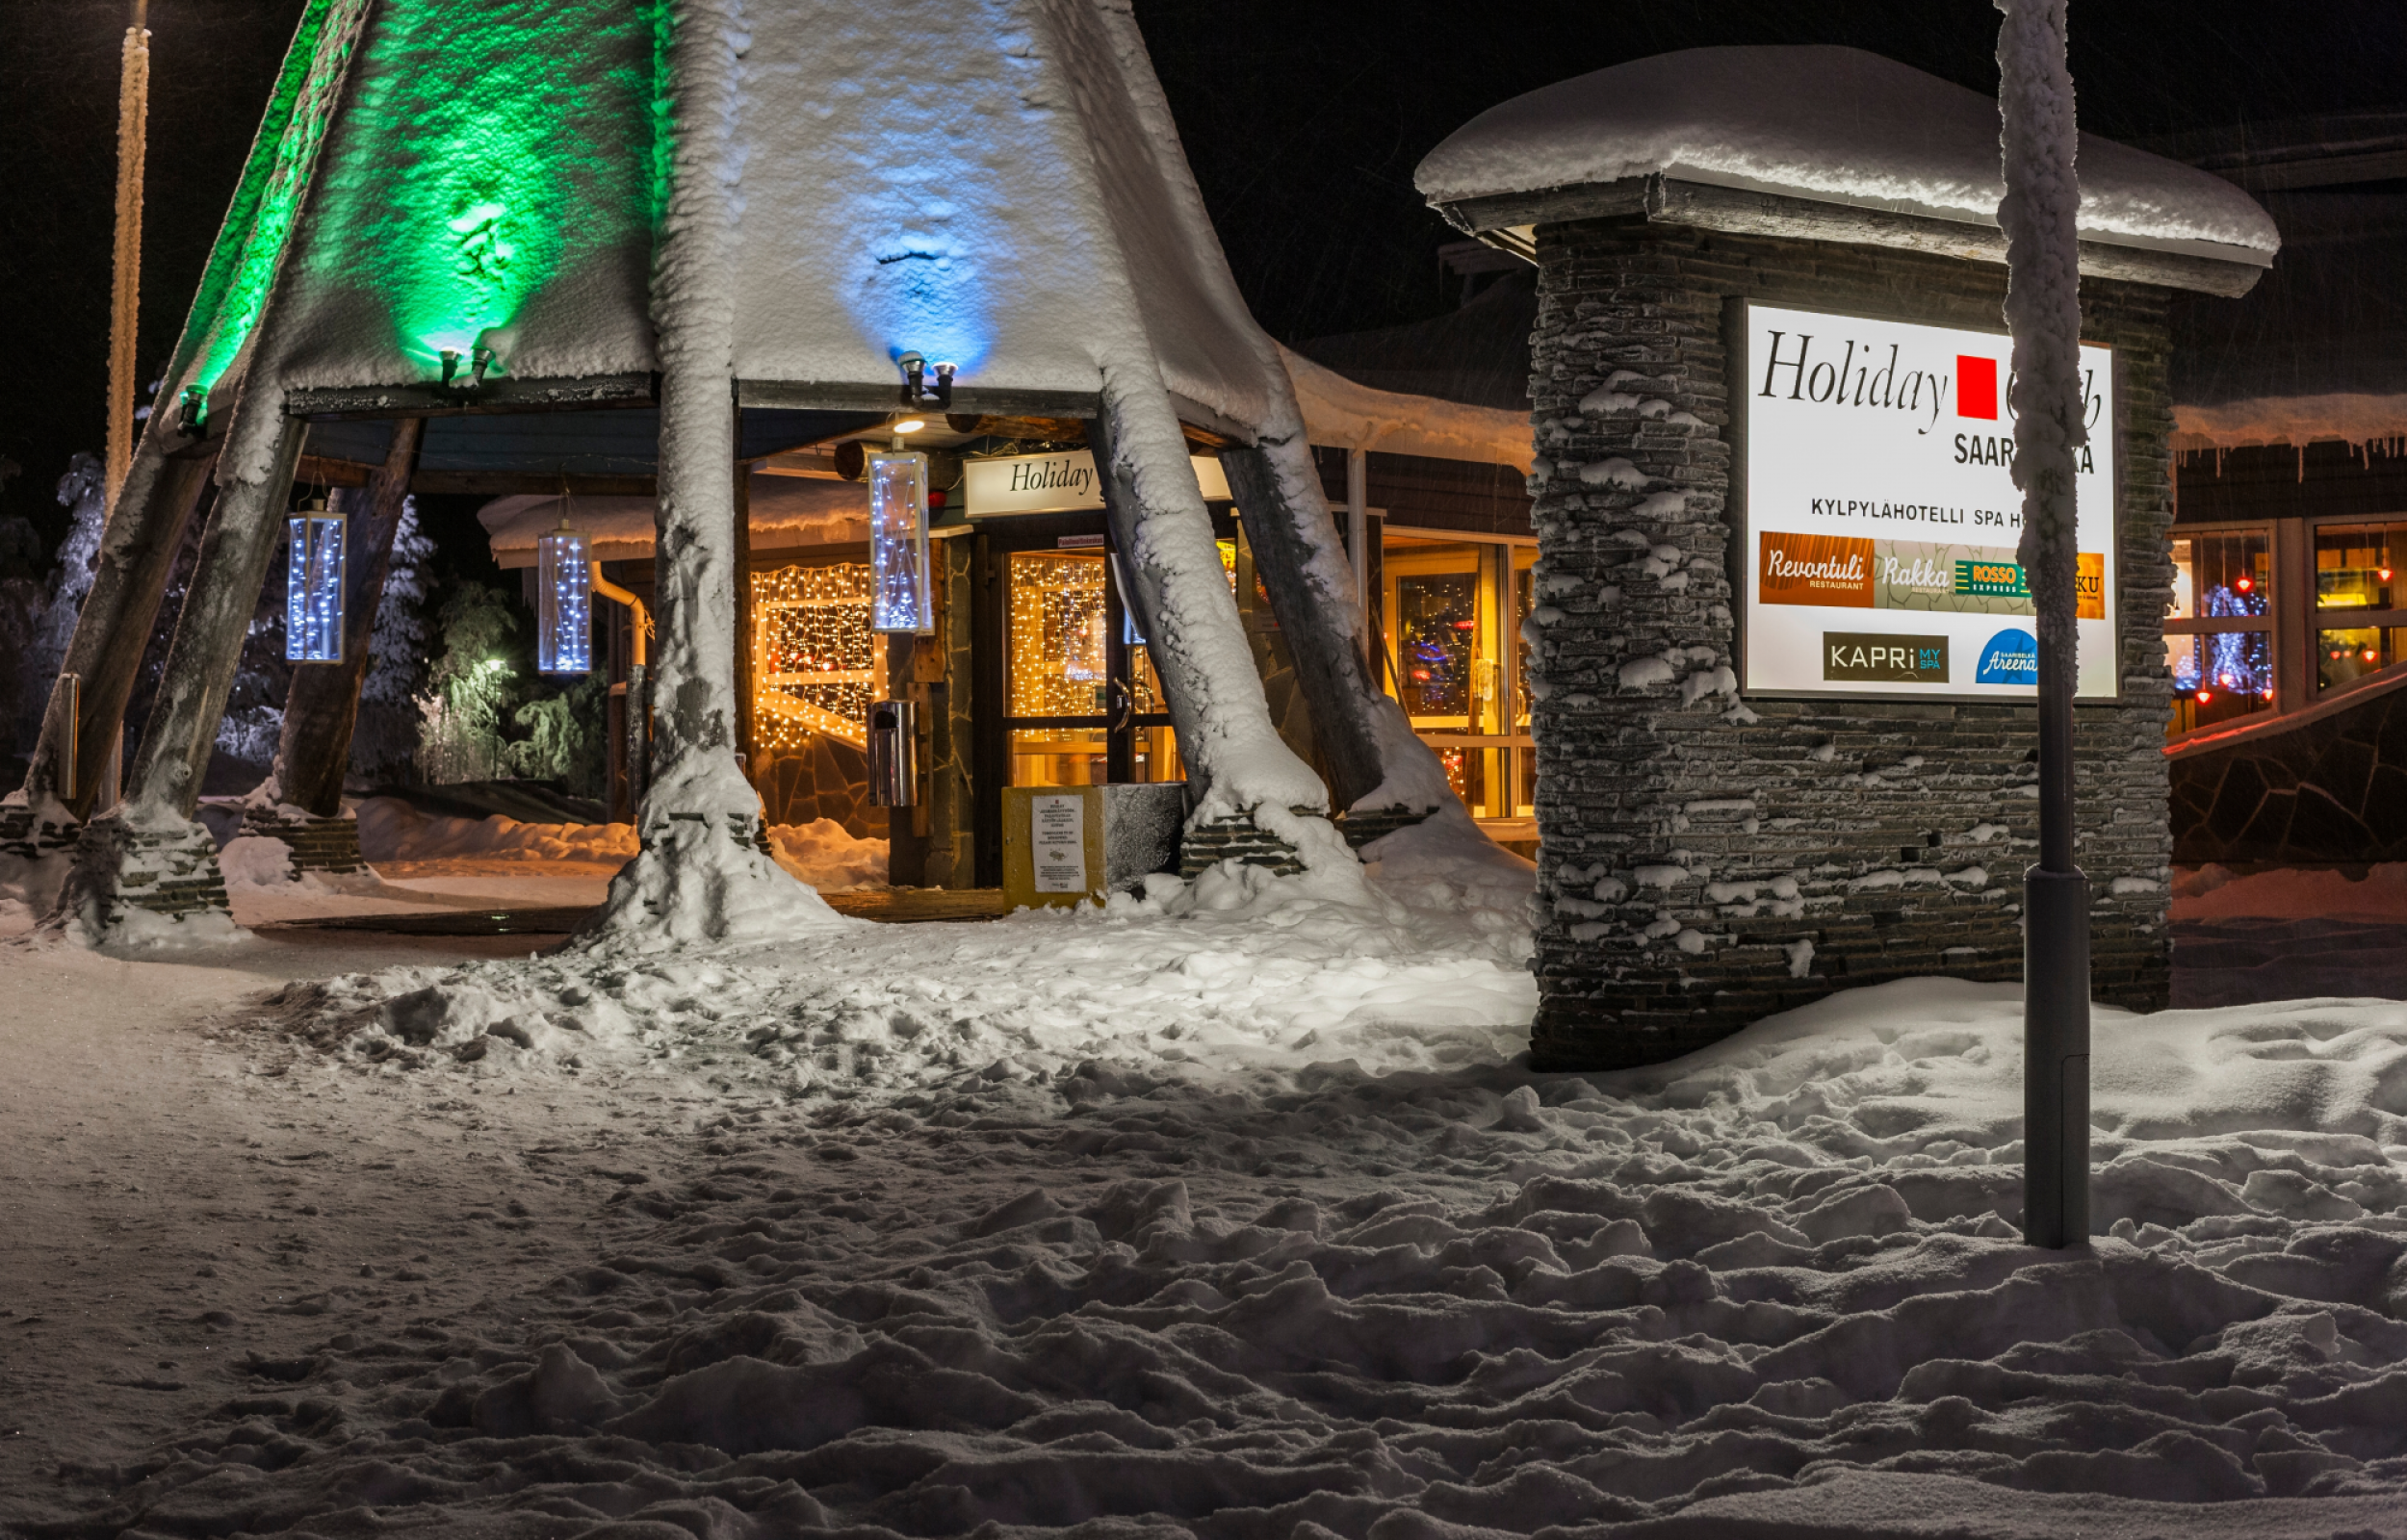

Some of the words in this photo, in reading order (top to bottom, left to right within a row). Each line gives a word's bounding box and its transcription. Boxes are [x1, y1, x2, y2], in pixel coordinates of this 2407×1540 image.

[1758, 330, 1948, 434] Holiday
[1010, 459, 1093, 496] Holiday
[1811, 499, 1964, 525] KYLPYLÄHOTELLI
[1974, 509, 2005, 527] SPA
[1768, 549, 1864, 580] Revontuli
[1882, 556, 1950, 587] Rakka
[1973, 565, 2016, 584] ROSSO
[1810, 580, 1864, 591] RESTAURANT
[1973, 583, 2016, 593] EXPRESS
[1919, 649, 1941, 660] MY
[1919, 659, 1941, 670] SPA
[1982, 651, 2037, 675] Areena
